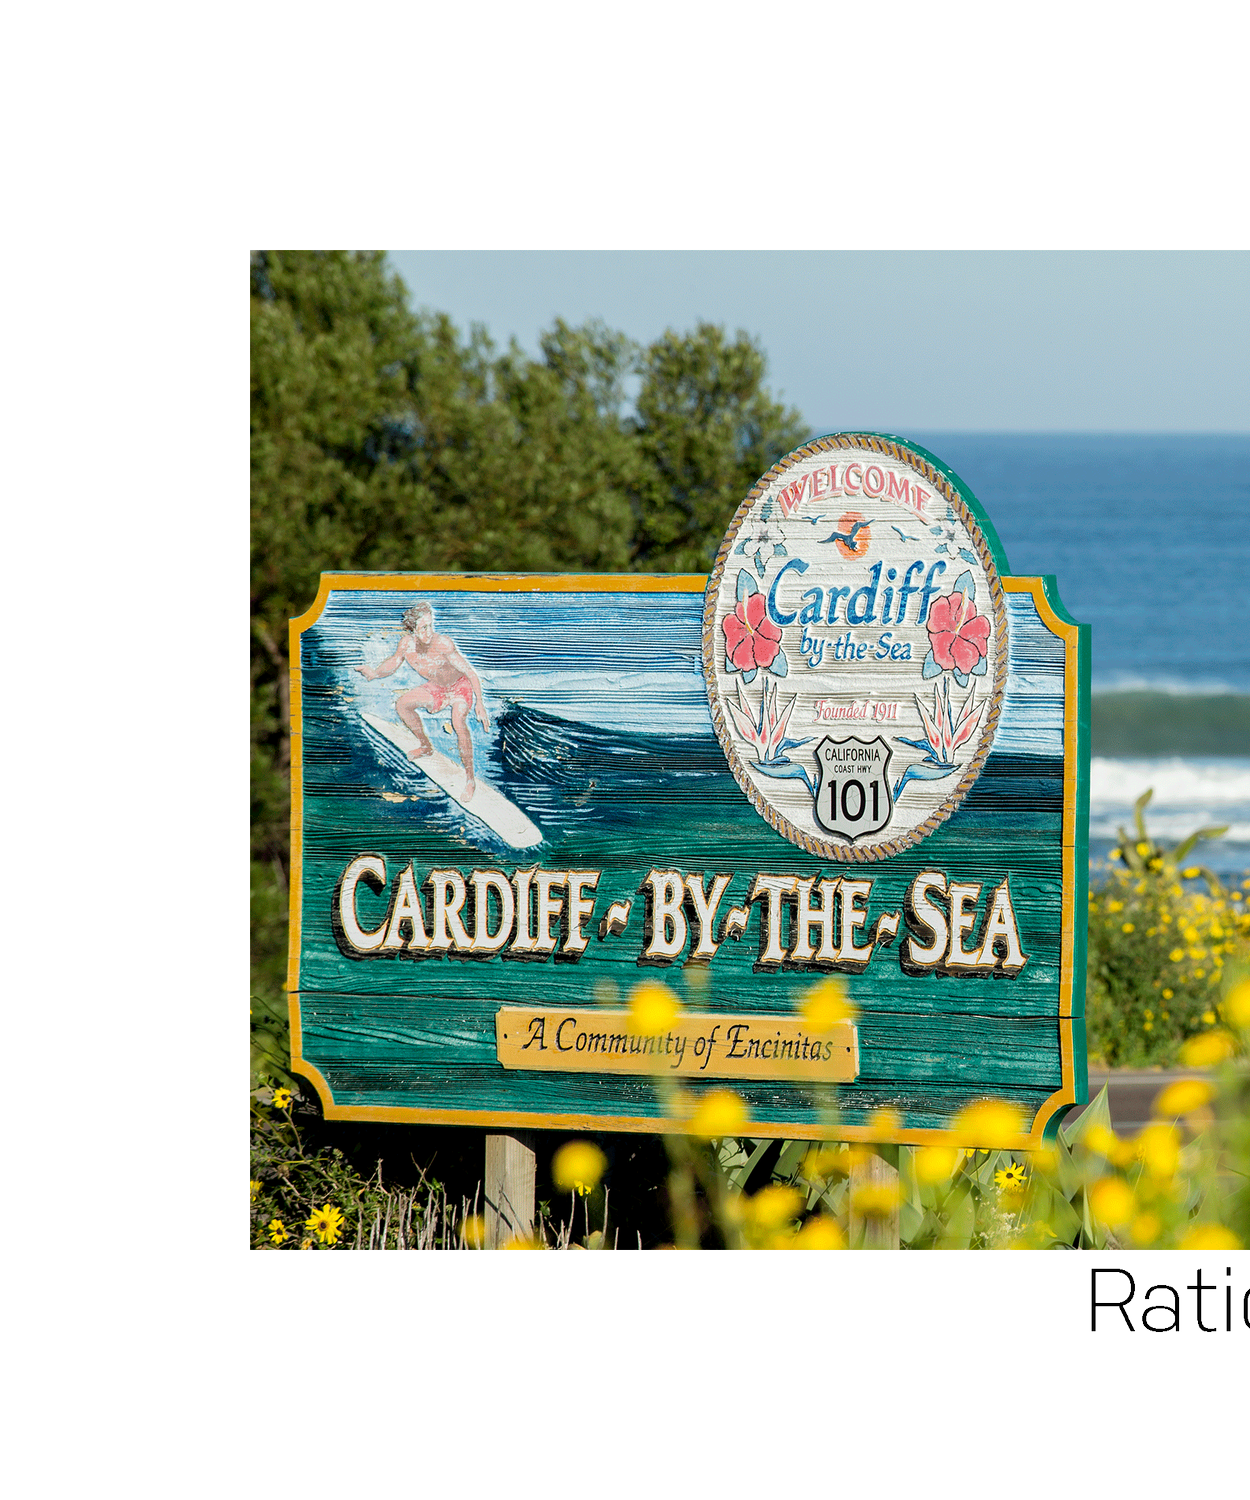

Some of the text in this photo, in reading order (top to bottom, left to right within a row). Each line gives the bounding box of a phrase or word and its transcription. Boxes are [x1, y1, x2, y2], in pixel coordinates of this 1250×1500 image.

[778, 462, 932, 524] WELCOME
[767, 558, 947, 626] Cardiff
[813, 700, 898, 722] Founded 1911
[825, 749, 881, 762] CALIFORNIA
[834, 765, 872, 773] COAST HWY
[827, 779, 879, 822] 101
[521, 1016, 834, 1071] A Community of Encinitas
